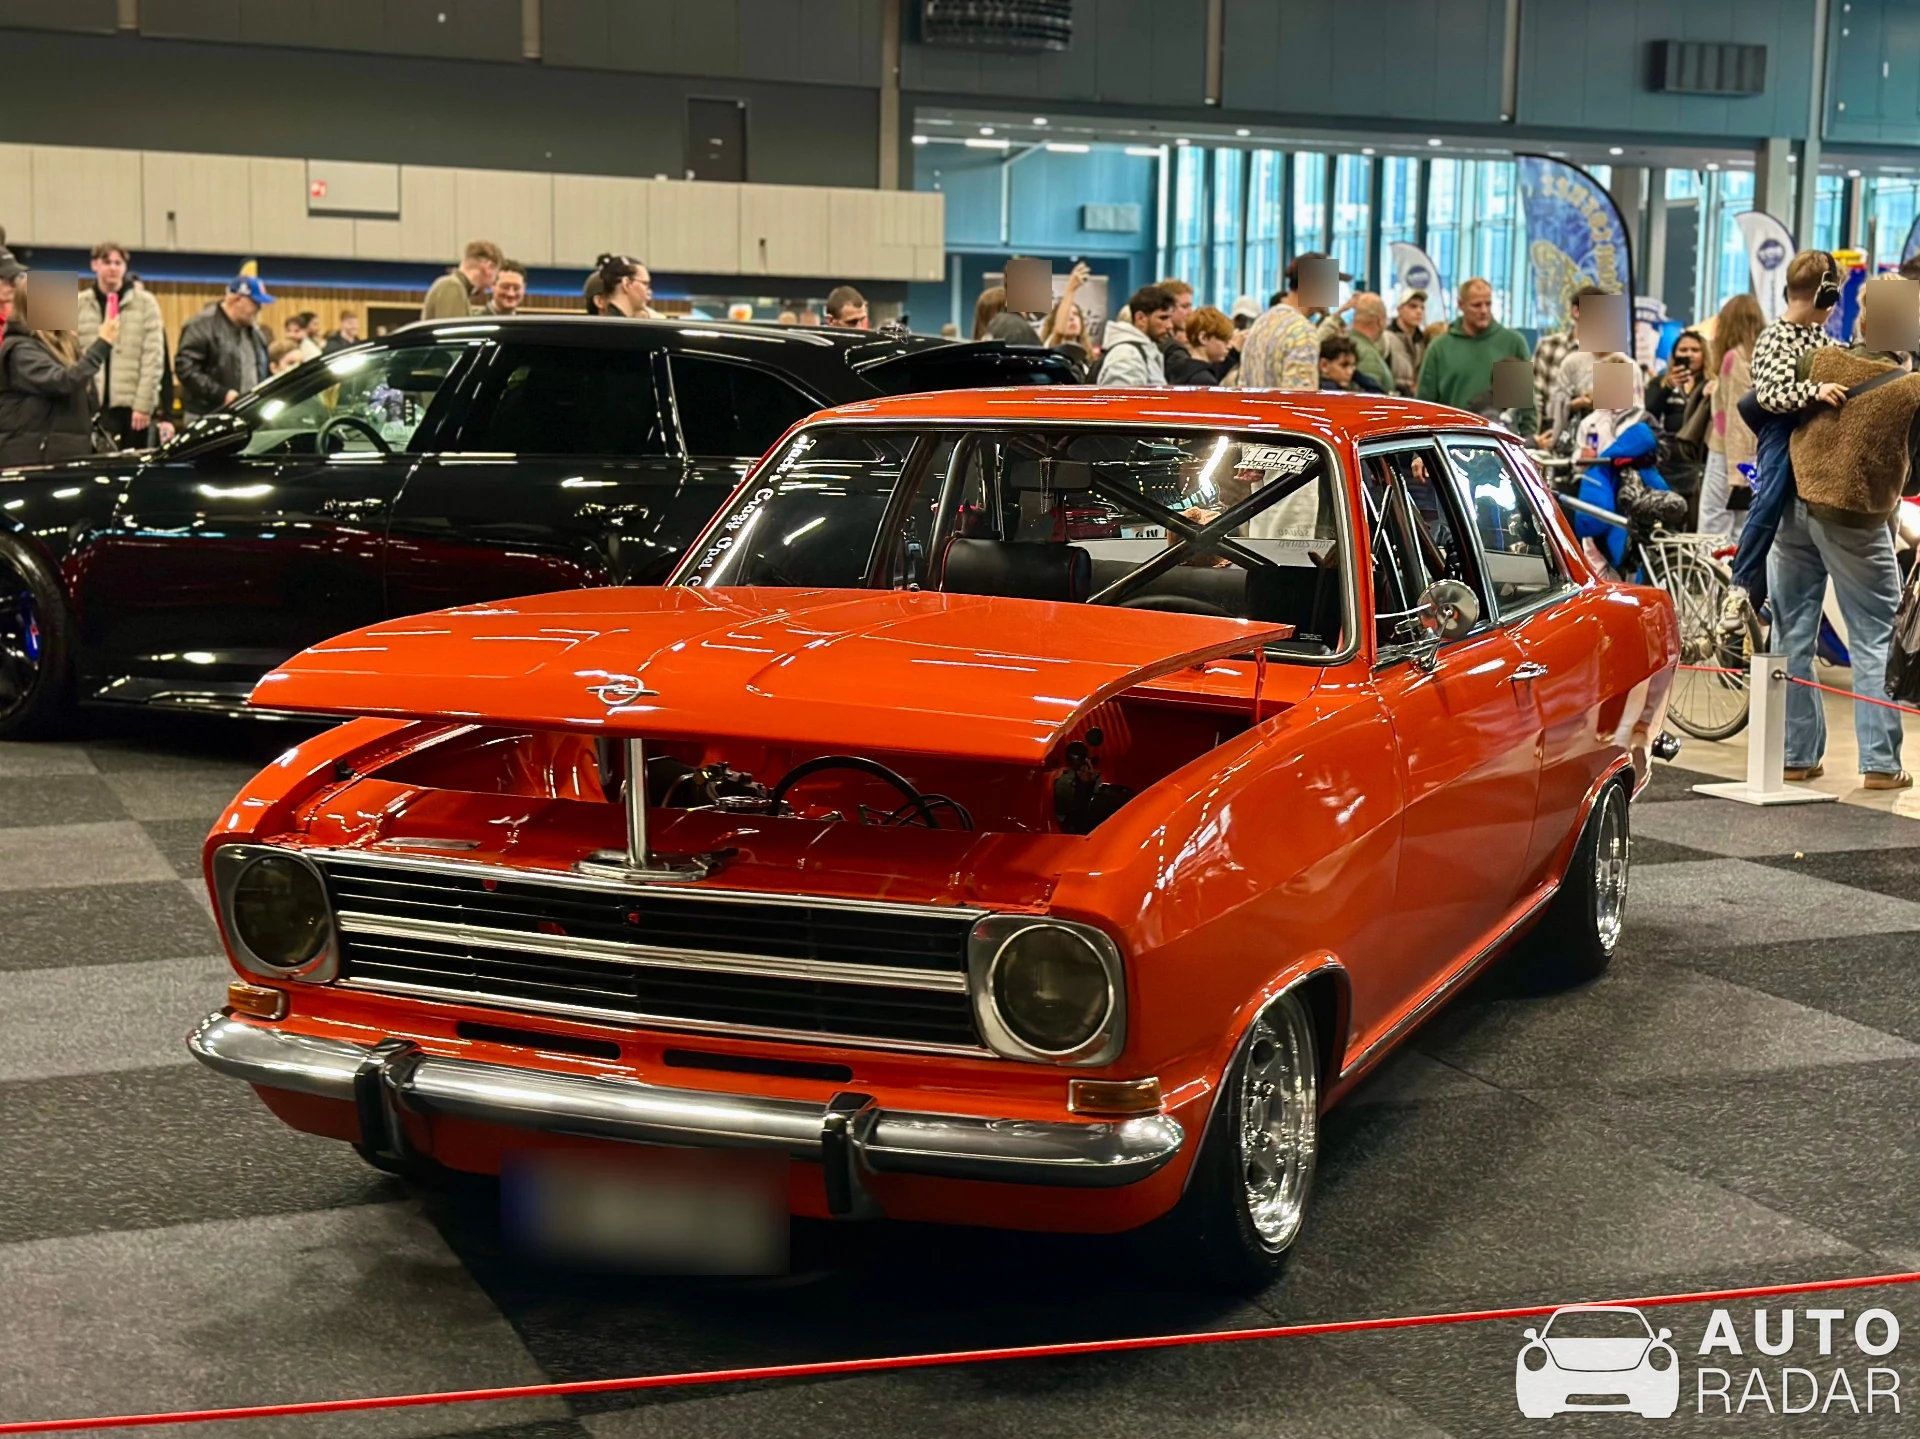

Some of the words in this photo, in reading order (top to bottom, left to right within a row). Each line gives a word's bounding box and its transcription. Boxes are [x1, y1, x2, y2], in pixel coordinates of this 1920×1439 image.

[404, 399, 413, 422] VIP
[1242, 447, 1319, 467] 100%
[725, 488, 774, 531] Crazy
[698, 536, 733, 570] Opel
